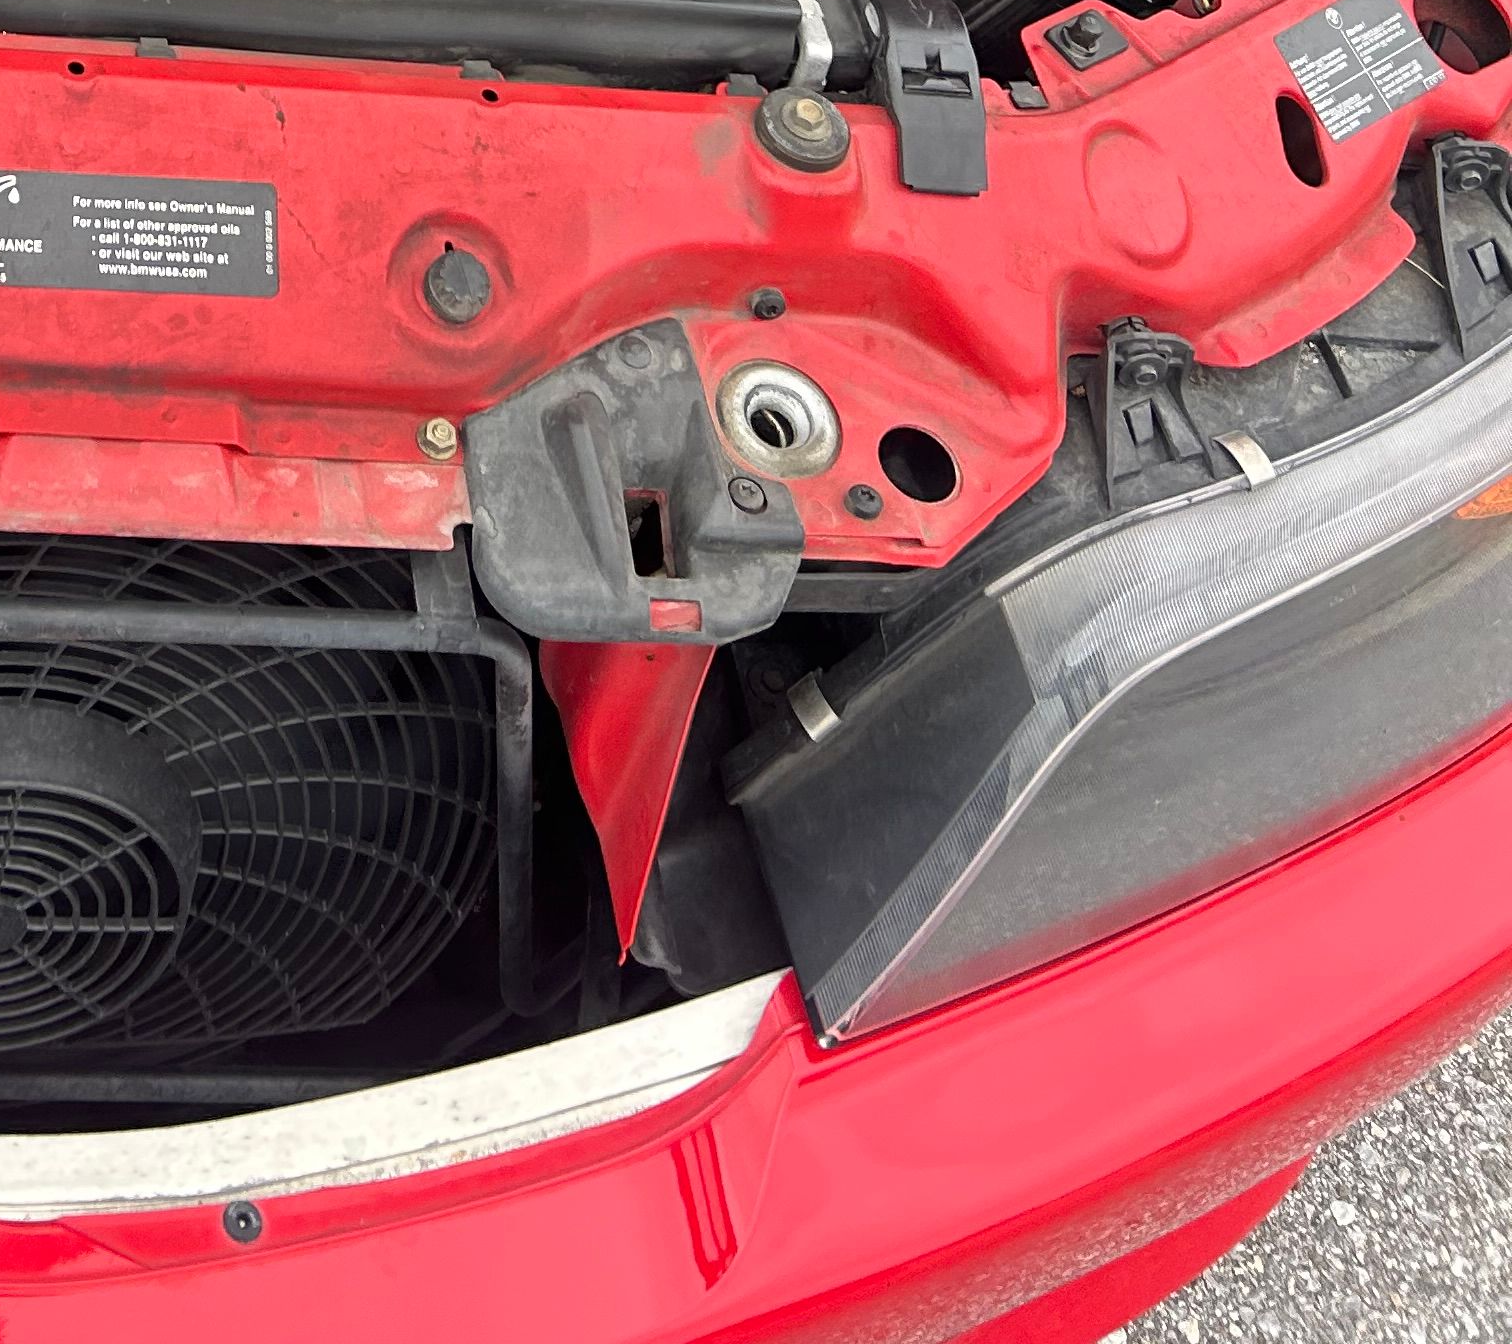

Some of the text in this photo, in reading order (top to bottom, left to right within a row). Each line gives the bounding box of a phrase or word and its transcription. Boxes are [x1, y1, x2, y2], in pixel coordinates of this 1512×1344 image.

[72, 195, 255, 215] For more info see Owner's Manual
[72, 215, 240, 235] For a list of other approved oils
[98, 232, 208, 249] call 1-800-831-1117
[98, 248, 229, 265] or visit our web site at
[98, 263, 208, 279] www.bmwusa.com
